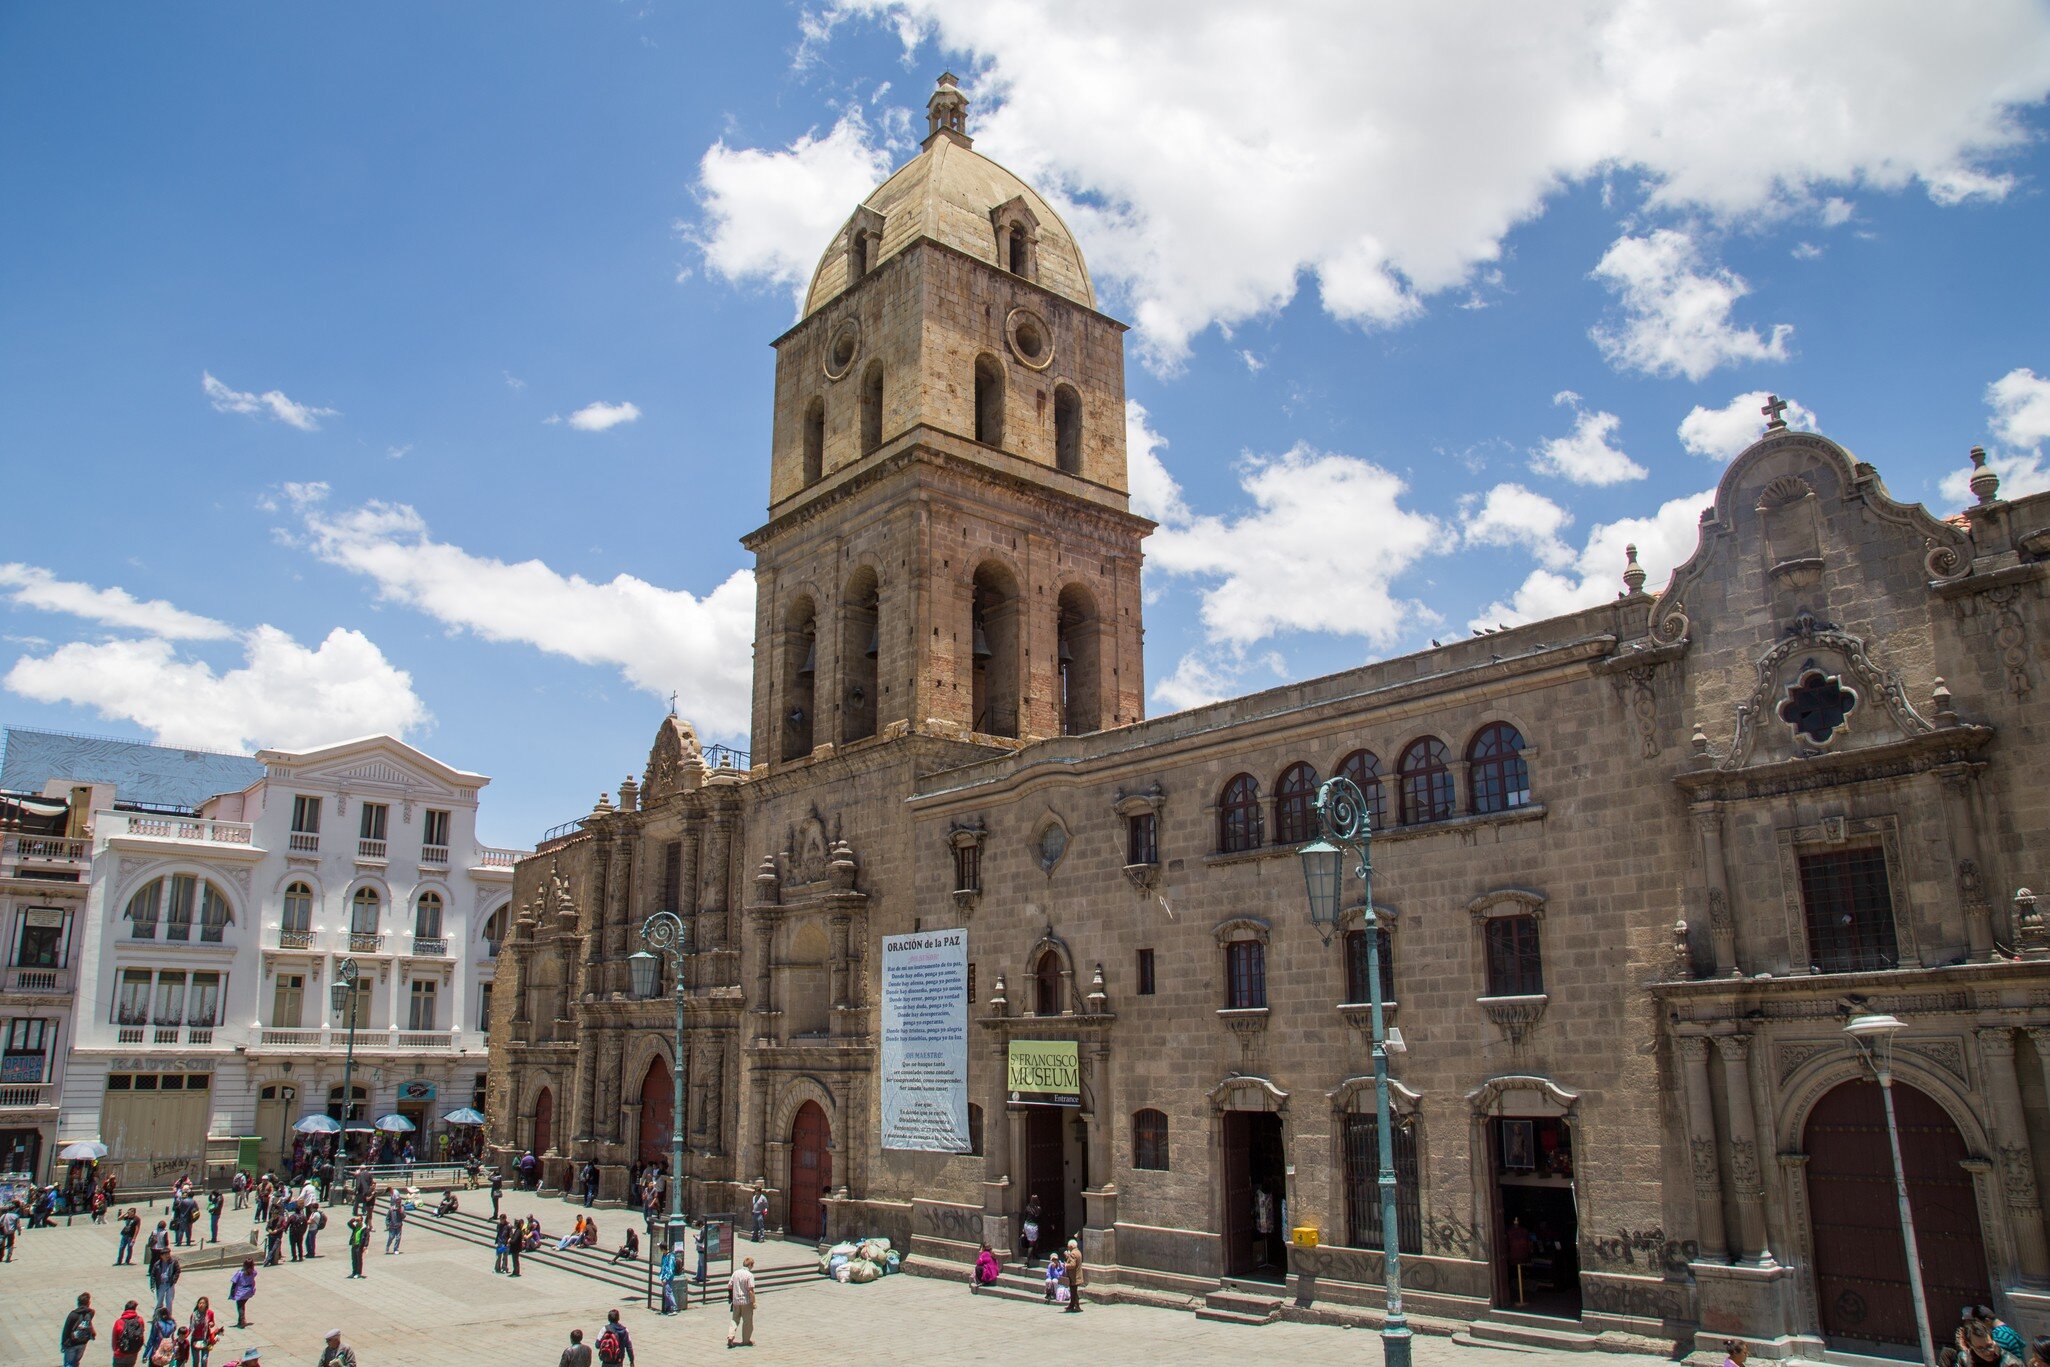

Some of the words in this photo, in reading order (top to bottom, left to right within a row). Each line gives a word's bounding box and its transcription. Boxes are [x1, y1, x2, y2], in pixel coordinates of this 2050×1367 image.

[888, 939, 922, 952] ORACIÓN
[925, 940, 933, 948] de
[935, 939, 942, 947] la
[944, 936, 960, 946] PAZ
[4, 1056, 42, 1070] OPTICA
[111, 1058, 216, 1070] KAUTSCH
[1019, 1054, 1077, 1068] FRANCISCO
[1010, 1067, 1078, 1088] MUSEUM
[1054, 1094, 1079, 1103] Entrance
